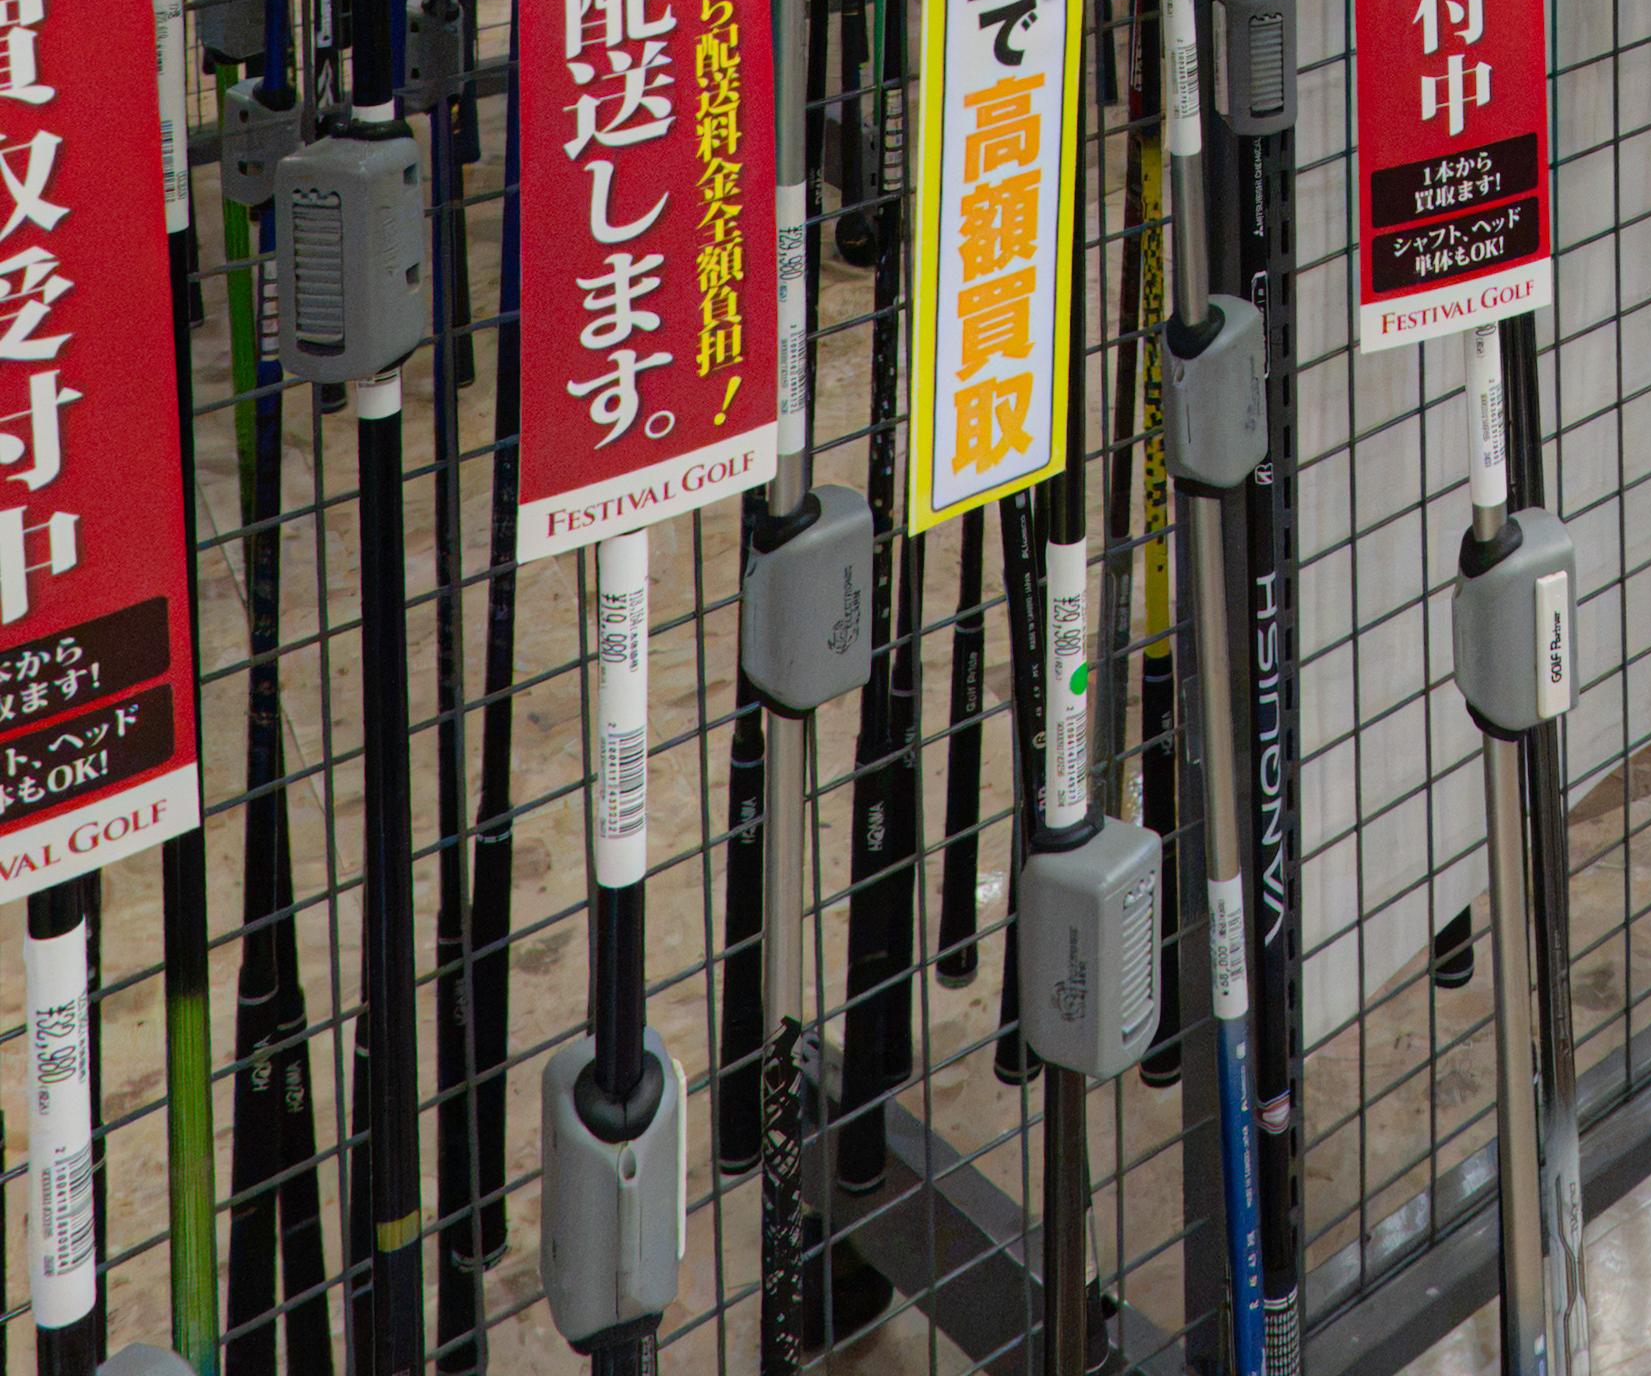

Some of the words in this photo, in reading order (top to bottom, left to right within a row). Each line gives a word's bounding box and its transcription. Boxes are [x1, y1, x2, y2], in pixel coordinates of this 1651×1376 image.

[1423, 151, 1492, 187] 1本から
[1394, 207, 1521, 257] シャフト、ヘッド
[1381, 297, 1475, 334] FESTIVAL
[1481, 279, 1534, 310] GOLF
[547, 481, 674, 539] FESTIVAL
[683, 450, 756, 493] GOLF
[1256, 570, 1285, 947] VANQUISH
[69, 799, 168, 854] GOLF
